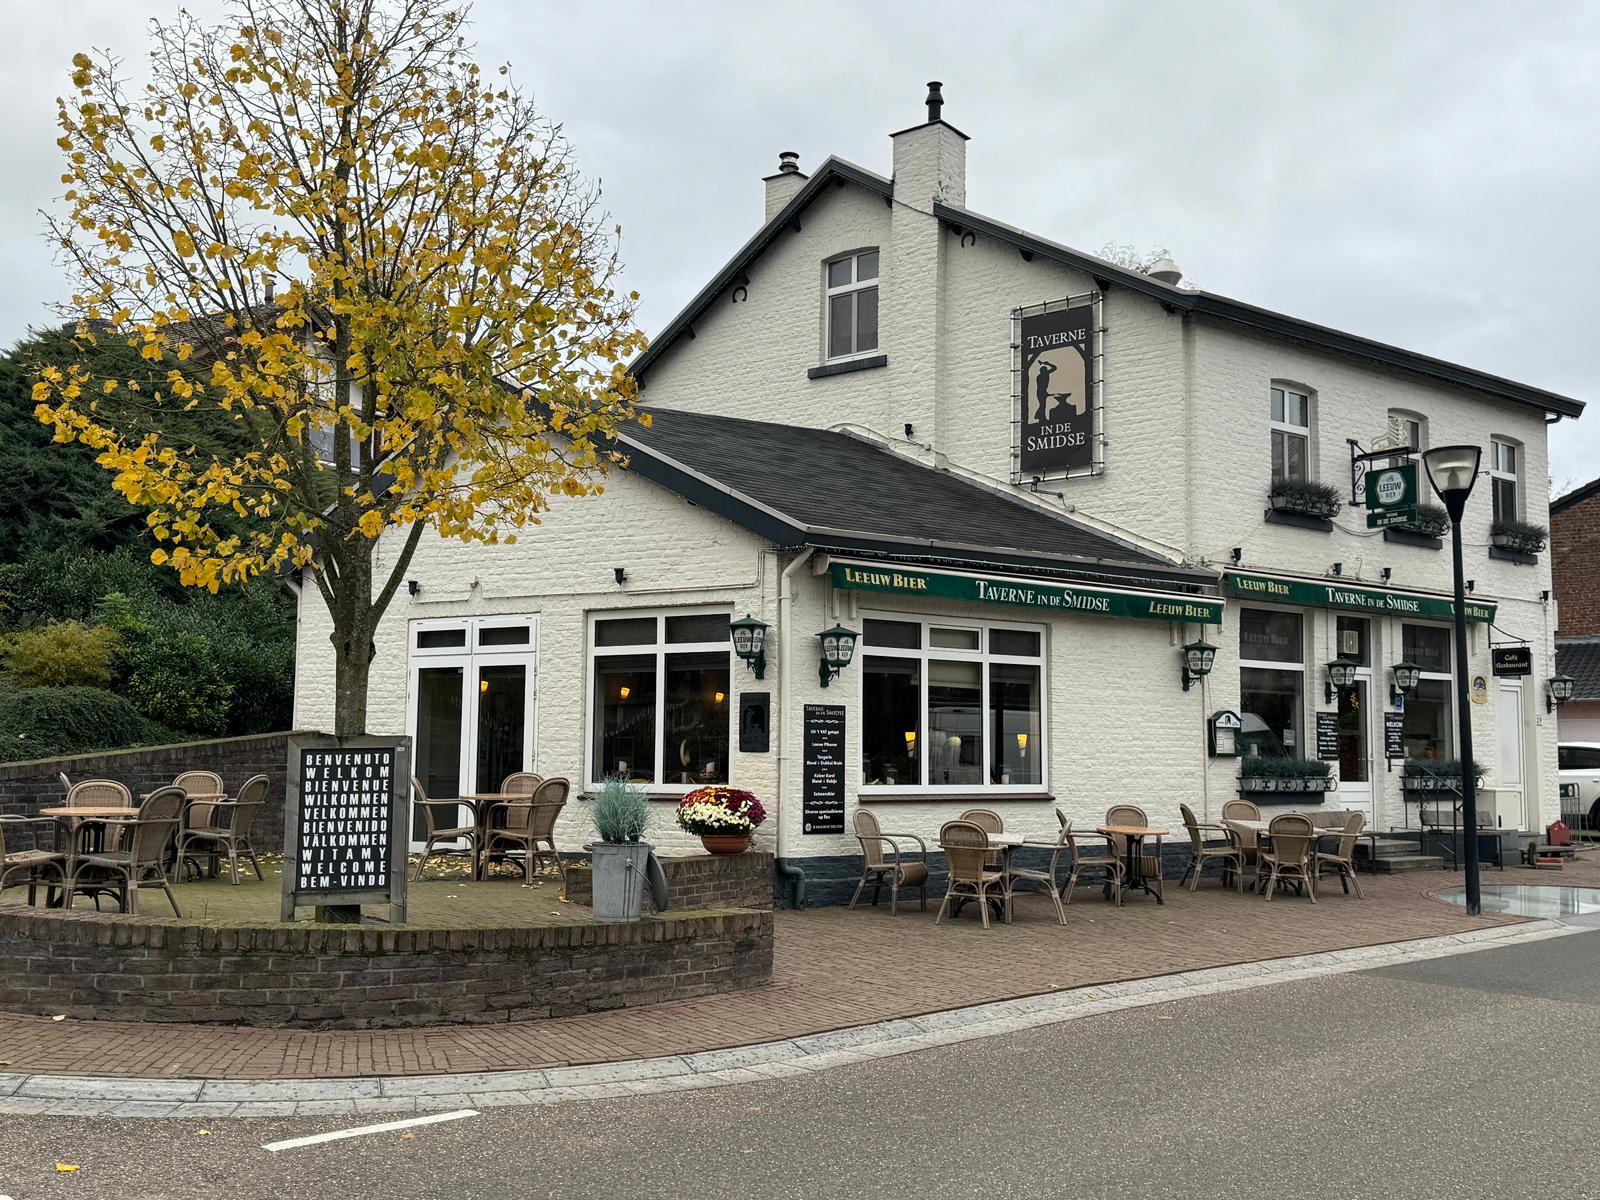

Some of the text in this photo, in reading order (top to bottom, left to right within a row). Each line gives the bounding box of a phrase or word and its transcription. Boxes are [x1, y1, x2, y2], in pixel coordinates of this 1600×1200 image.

[1028, 328, 1086, 348] TAVERNE
[1041, 423, 1071, 435] IN DE
[1028, 432, 1085, 451] SMIDSE
[1380, 482, 1402, 492] LEEUW
[845, 568, 927, 589] LEEUW BIER
[1236, 577, 1289, 594] LEEUW BIER
[976, 581, 1110, 611] TAVERNE IN DE SMIDSE
[1326, 587, 1420, 611] TAVERNE IN DE SMIDSE
[1149, 601, 1210, 617] LEEUW BIER
[1473, 606, 1489, 618] BIER
[306, 753, 390, 765] BENVENUTO
[306, 766, 389, 778] WELKOM
[305, 780, 388, 792] BIENVENUE
[305, 793, 388, 806] WILKOMMEN
[304, 806, 388, 820] VELKOMMEN
[303, 820, 387, 833] BIENVENIDO
[303, 833, 387, 847] VÄLKOMMEN
[302, 848, 386, 861] WITAMY
[302, 861, 386, 874] WELCOME
[301, 875, 385, 888] BEM-VINDO
